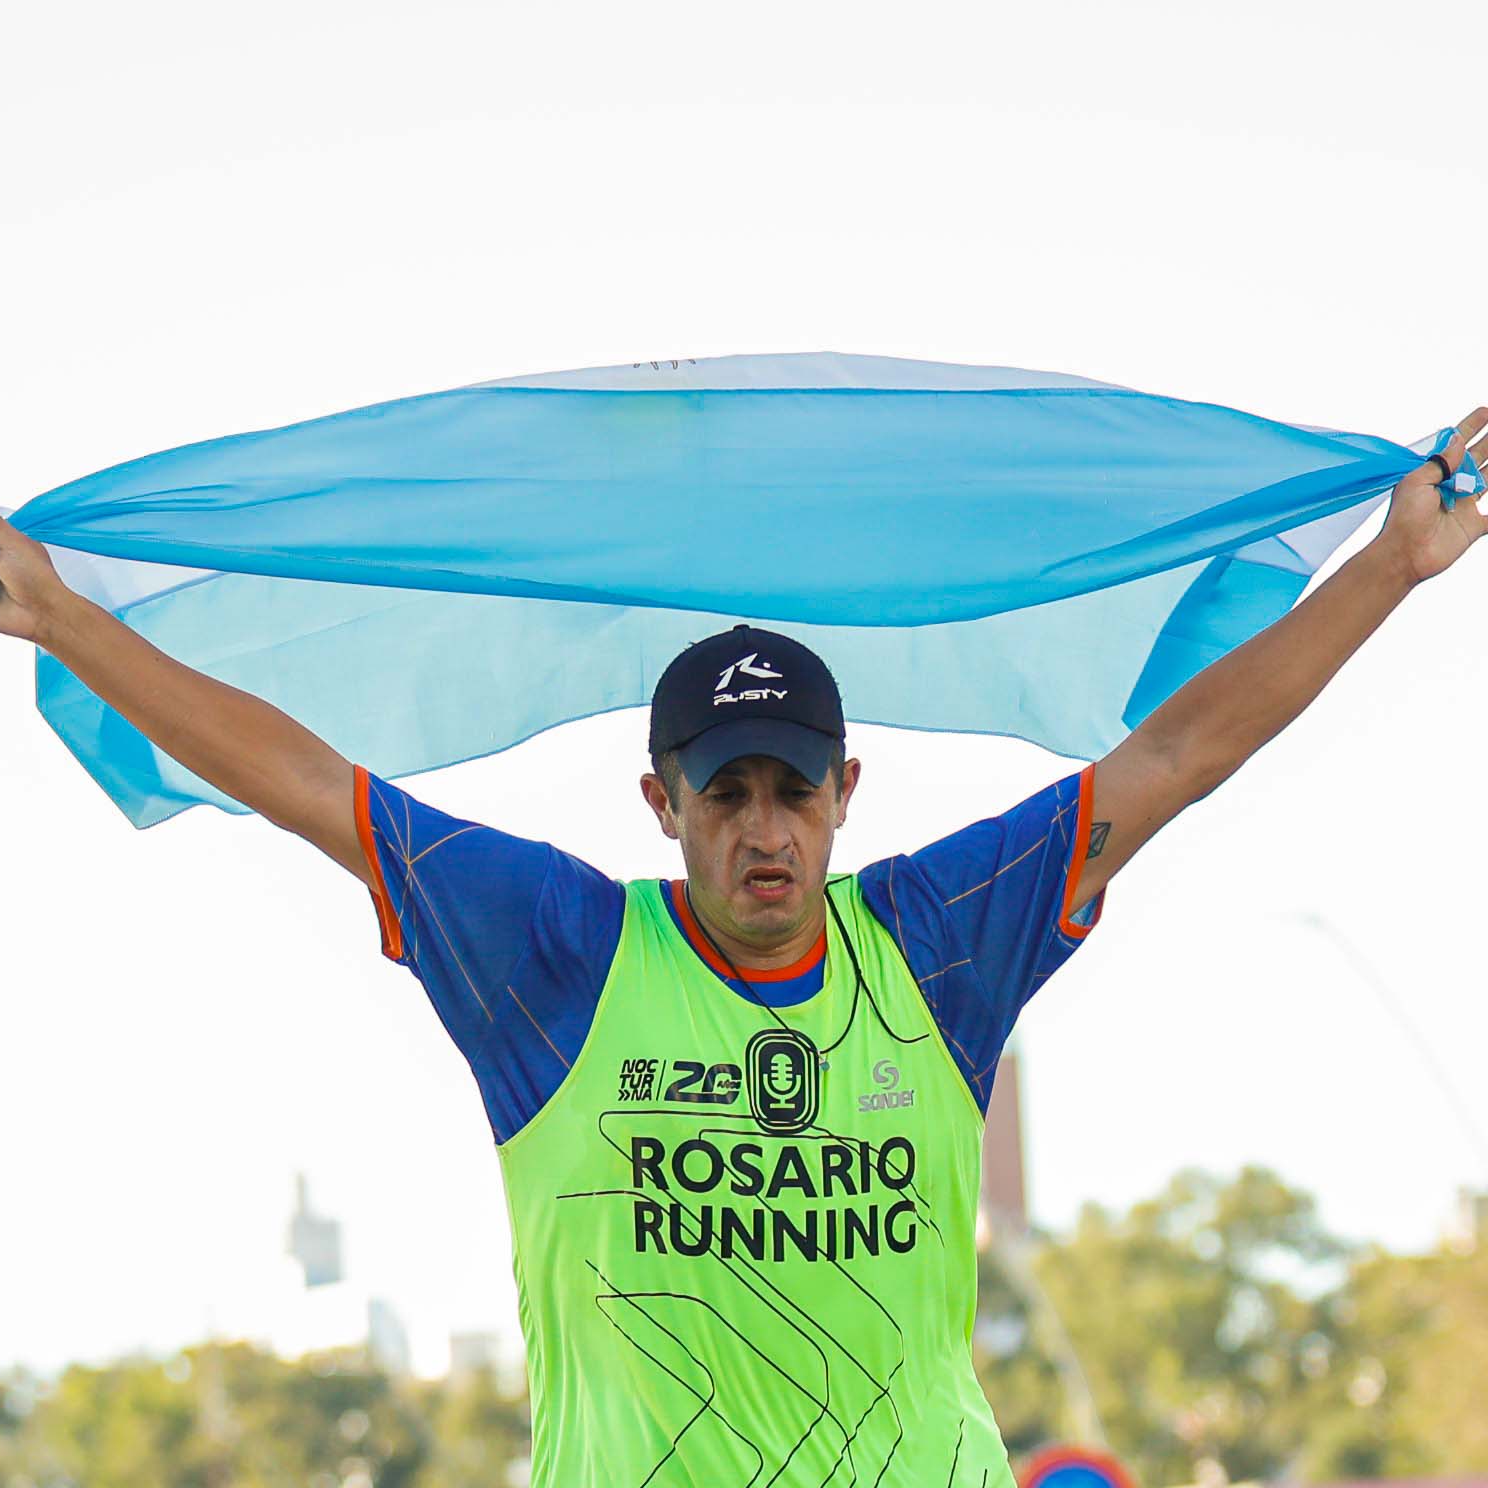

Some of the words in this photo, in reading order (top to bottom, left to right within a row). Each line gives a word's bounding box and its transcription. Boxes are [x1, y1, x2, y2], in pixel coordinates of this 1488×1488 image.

[713, 688, 788, 706] RUSTY
[621, 1059, 659, 1074] NOC
[619, 1073, 655, 1089] TUR
[631, 1136, 916, 1199] ROSARIO
[634, 1200, 917, 1263] RUNNING
